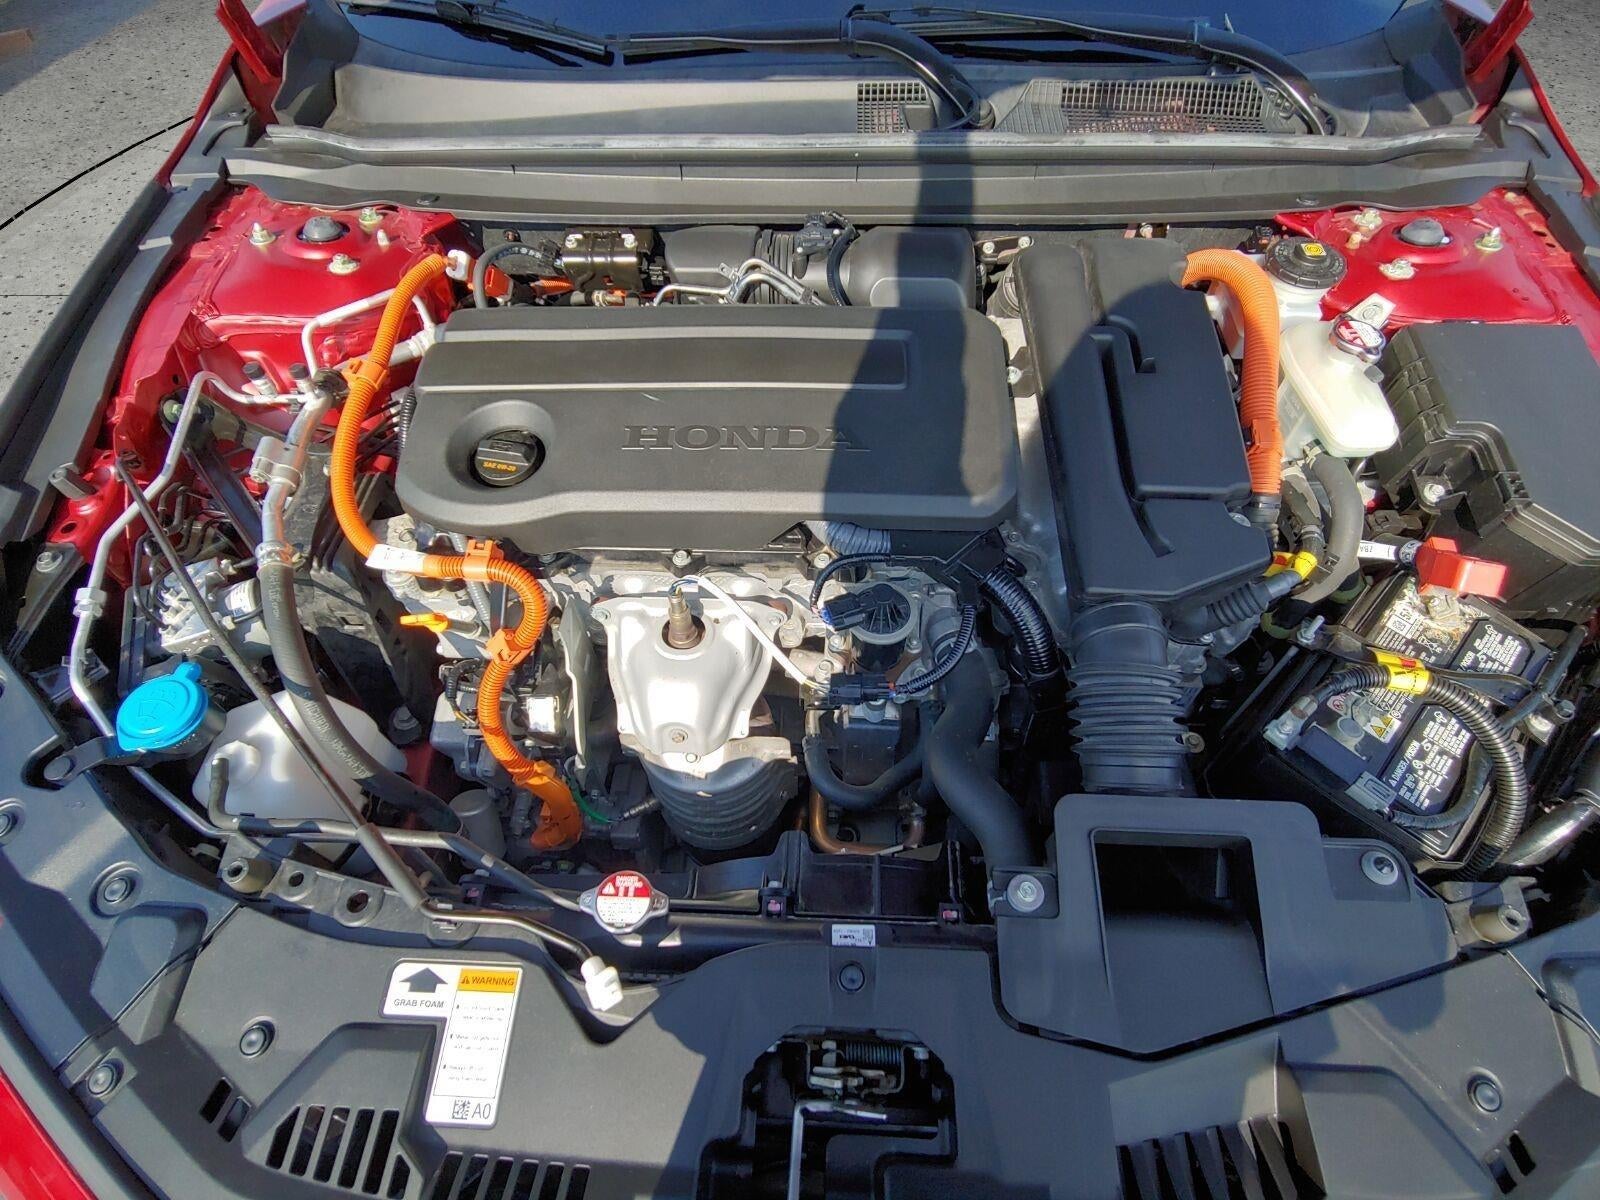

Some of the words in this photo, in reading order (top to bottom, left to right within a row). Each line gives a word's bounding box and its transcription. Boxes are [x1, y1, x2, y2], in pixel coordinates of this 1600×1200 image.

[621, 424, 872, 452] HONDA
[471, 976, 515, 986] WARNING
[393, 998, 418, 1007] GRAB
[419, 999, 445, 1008] FOAM
